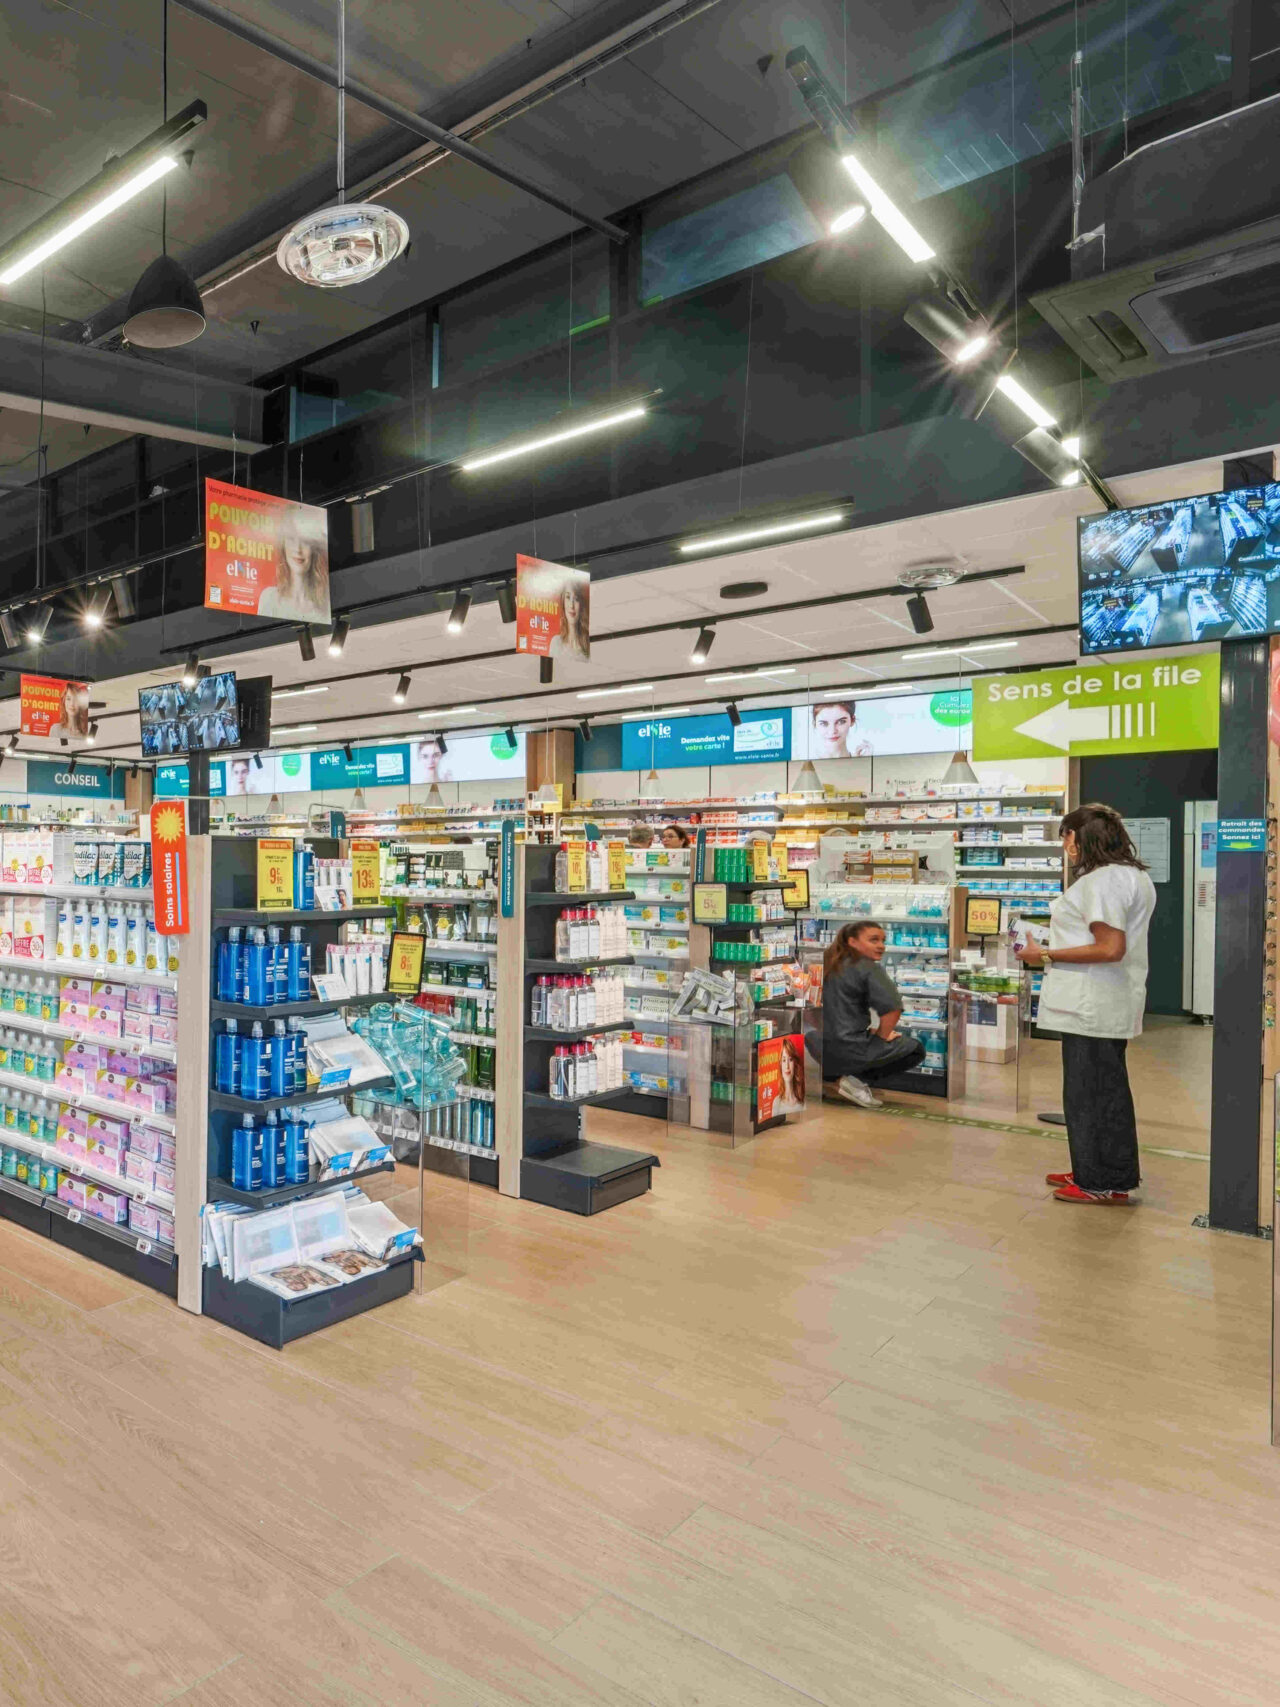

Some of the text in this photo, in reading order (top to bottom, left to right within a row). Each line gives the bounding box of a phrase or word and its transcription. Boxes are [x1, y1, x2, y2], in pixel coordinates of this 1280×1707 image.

[209, 502, 274, 533] POUVOIR
[208, 531, 274, 561] D'ACHAT
[22, 685, 60, 698] POUVOIR
[988, 665, 1202, 703] Sens de la file
[22, 699, 59, 711] D'ACHAT
[638, 723, 671, 737] elsie
[681, 734, 730, 745] Demandez vite
[54, 772, 100, 788] CONSEIL
[161, 852, 174, 927] Soins solaires
[971, 910, 997, 921] 50%
